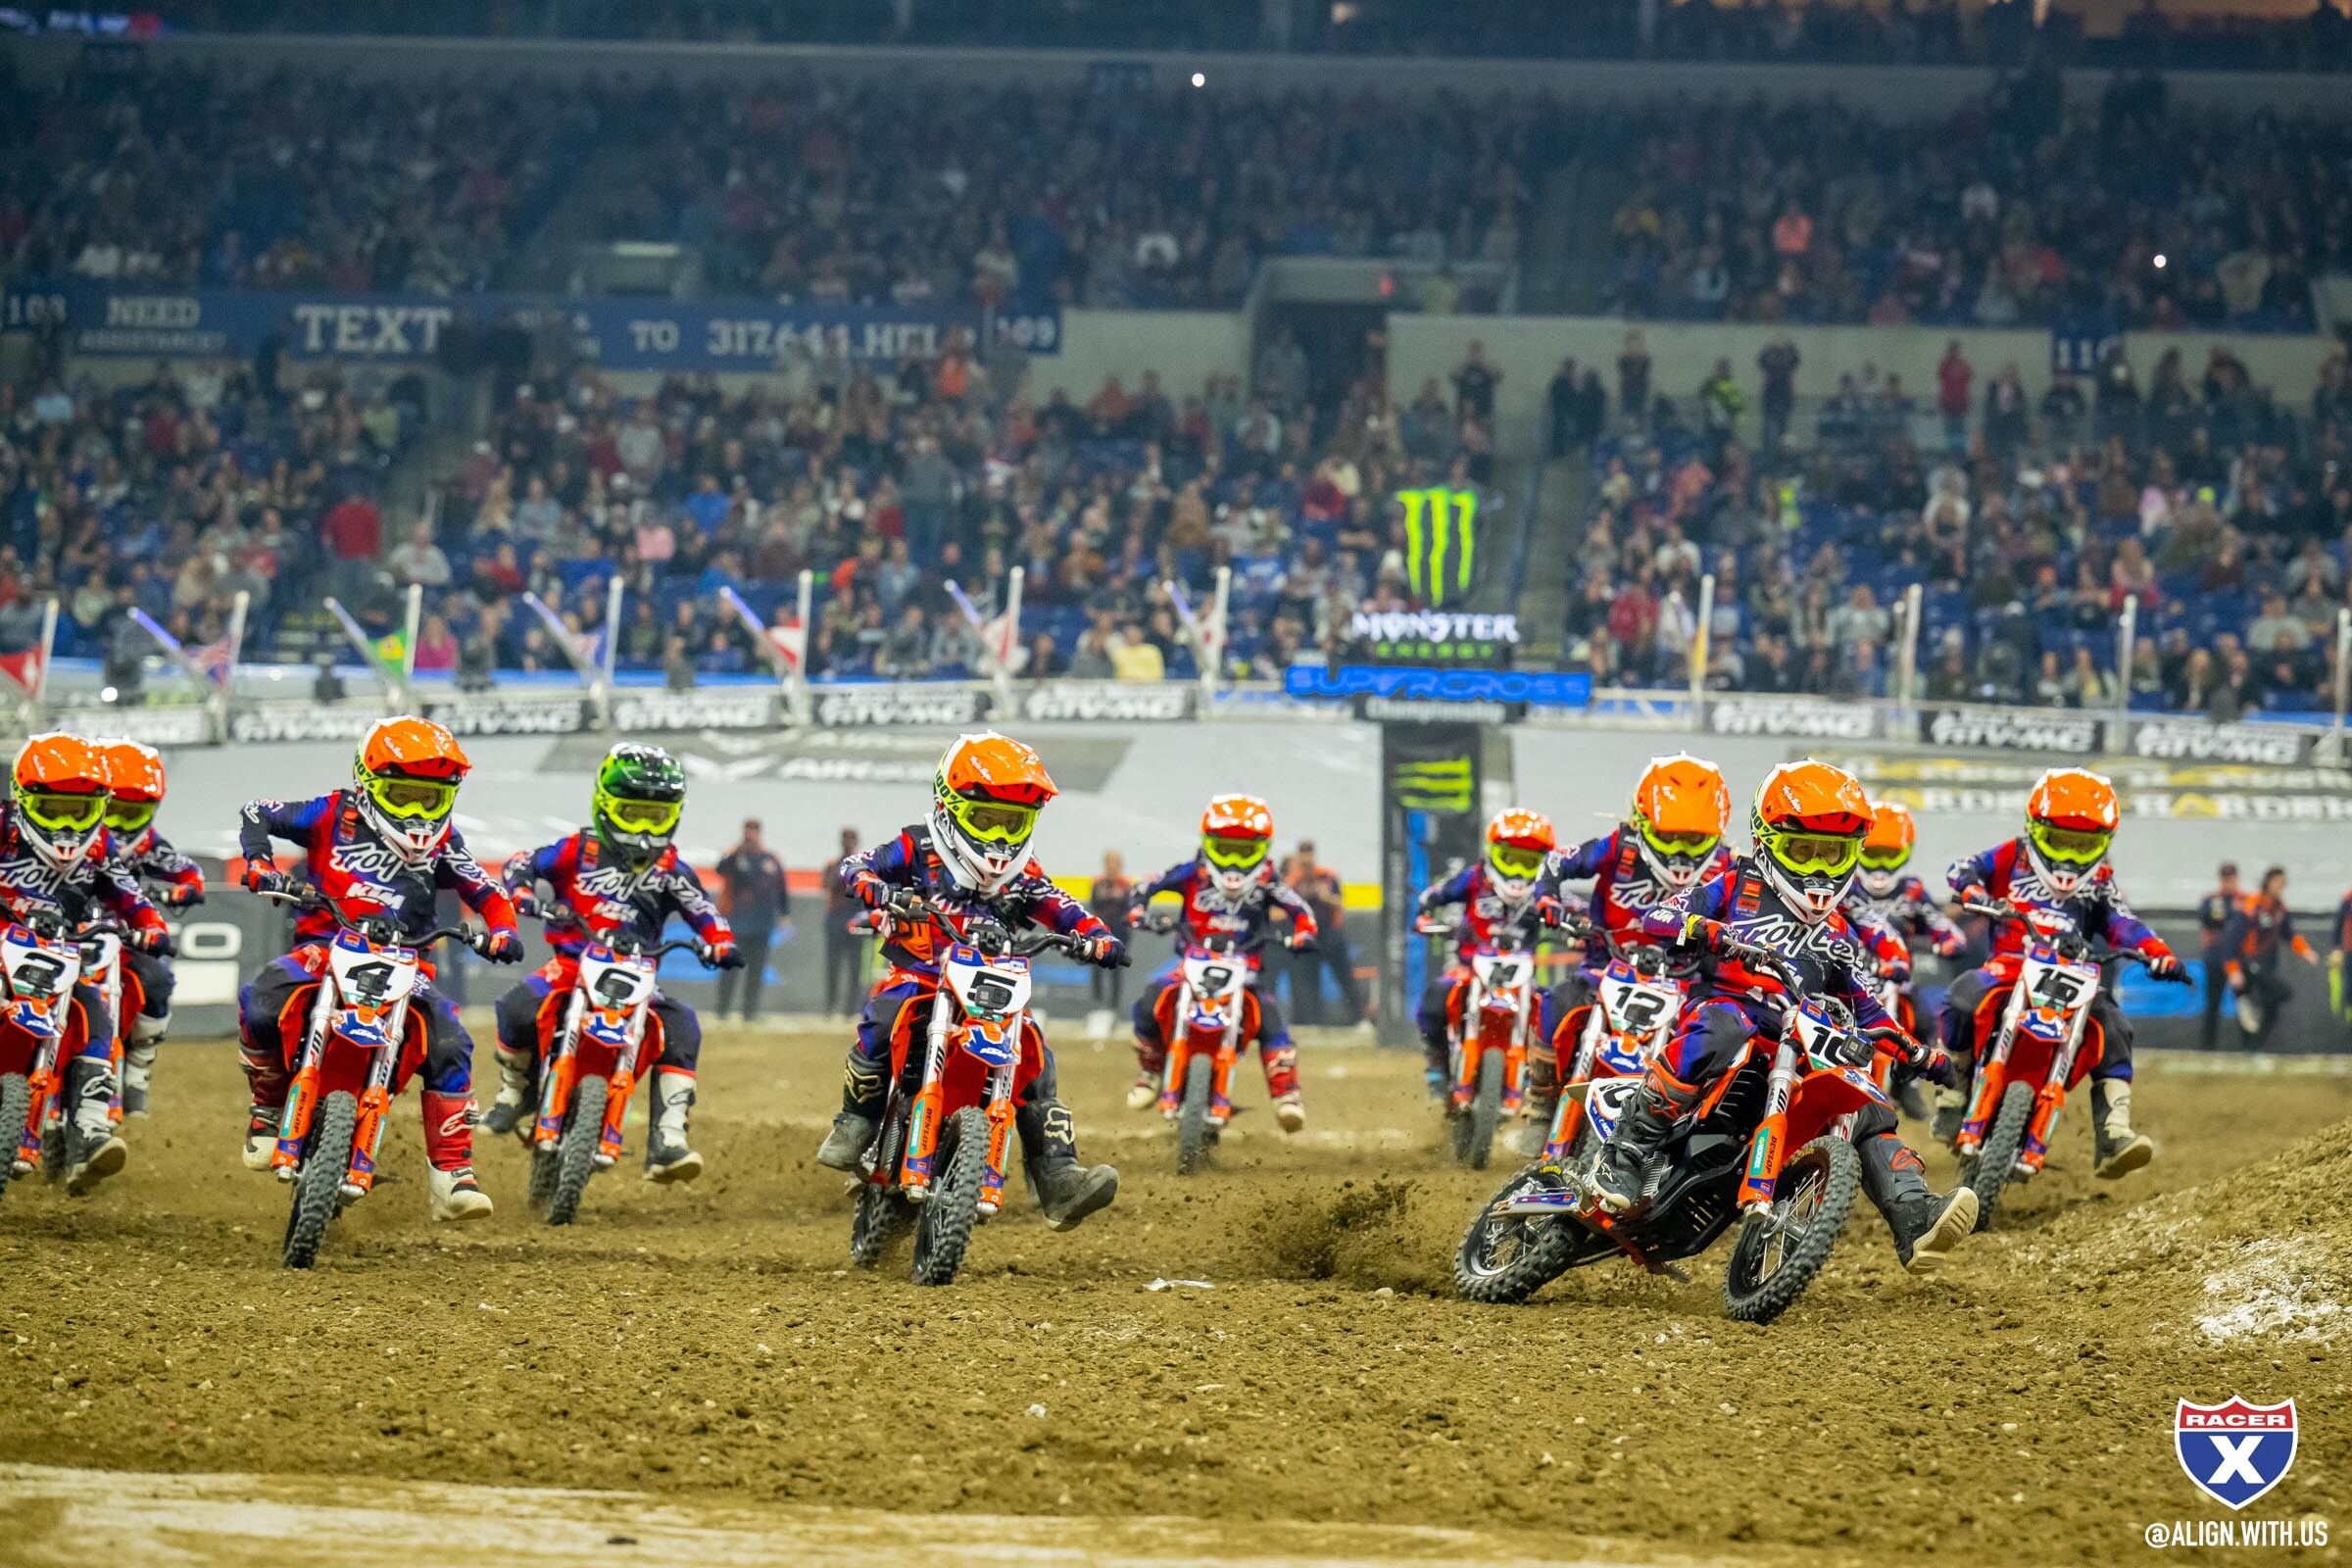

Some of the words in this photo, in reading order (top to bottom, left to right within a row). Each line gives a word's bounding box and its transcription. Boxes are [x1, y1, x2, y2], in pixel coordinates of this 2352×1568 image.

[106, 296, 201, 327] NEED
[296, 305, 452, 352] TEXT
[630, 319, 678, 353] TO
[1351, 611, 1519, 644] MONSTER
[330, 842, 405, 883] Troy
[346, 881, 406, 910] KTM
[1649, 908, 1676, 924] KTM
[1729, 913, 1813, 959] Troy
[344, 961, 396, 992] 4
[594, 967, 642, 1001] 6
[966, 970, 1017, 1010] 5
[294, 1091, 307, 1135] DUNLOP
[366, 1110, 379, 1154] DUNLOP
[922, 1106, 933, 1152] DUNLOP
[1766, 1134, 1779, 1175] DUNLOP
